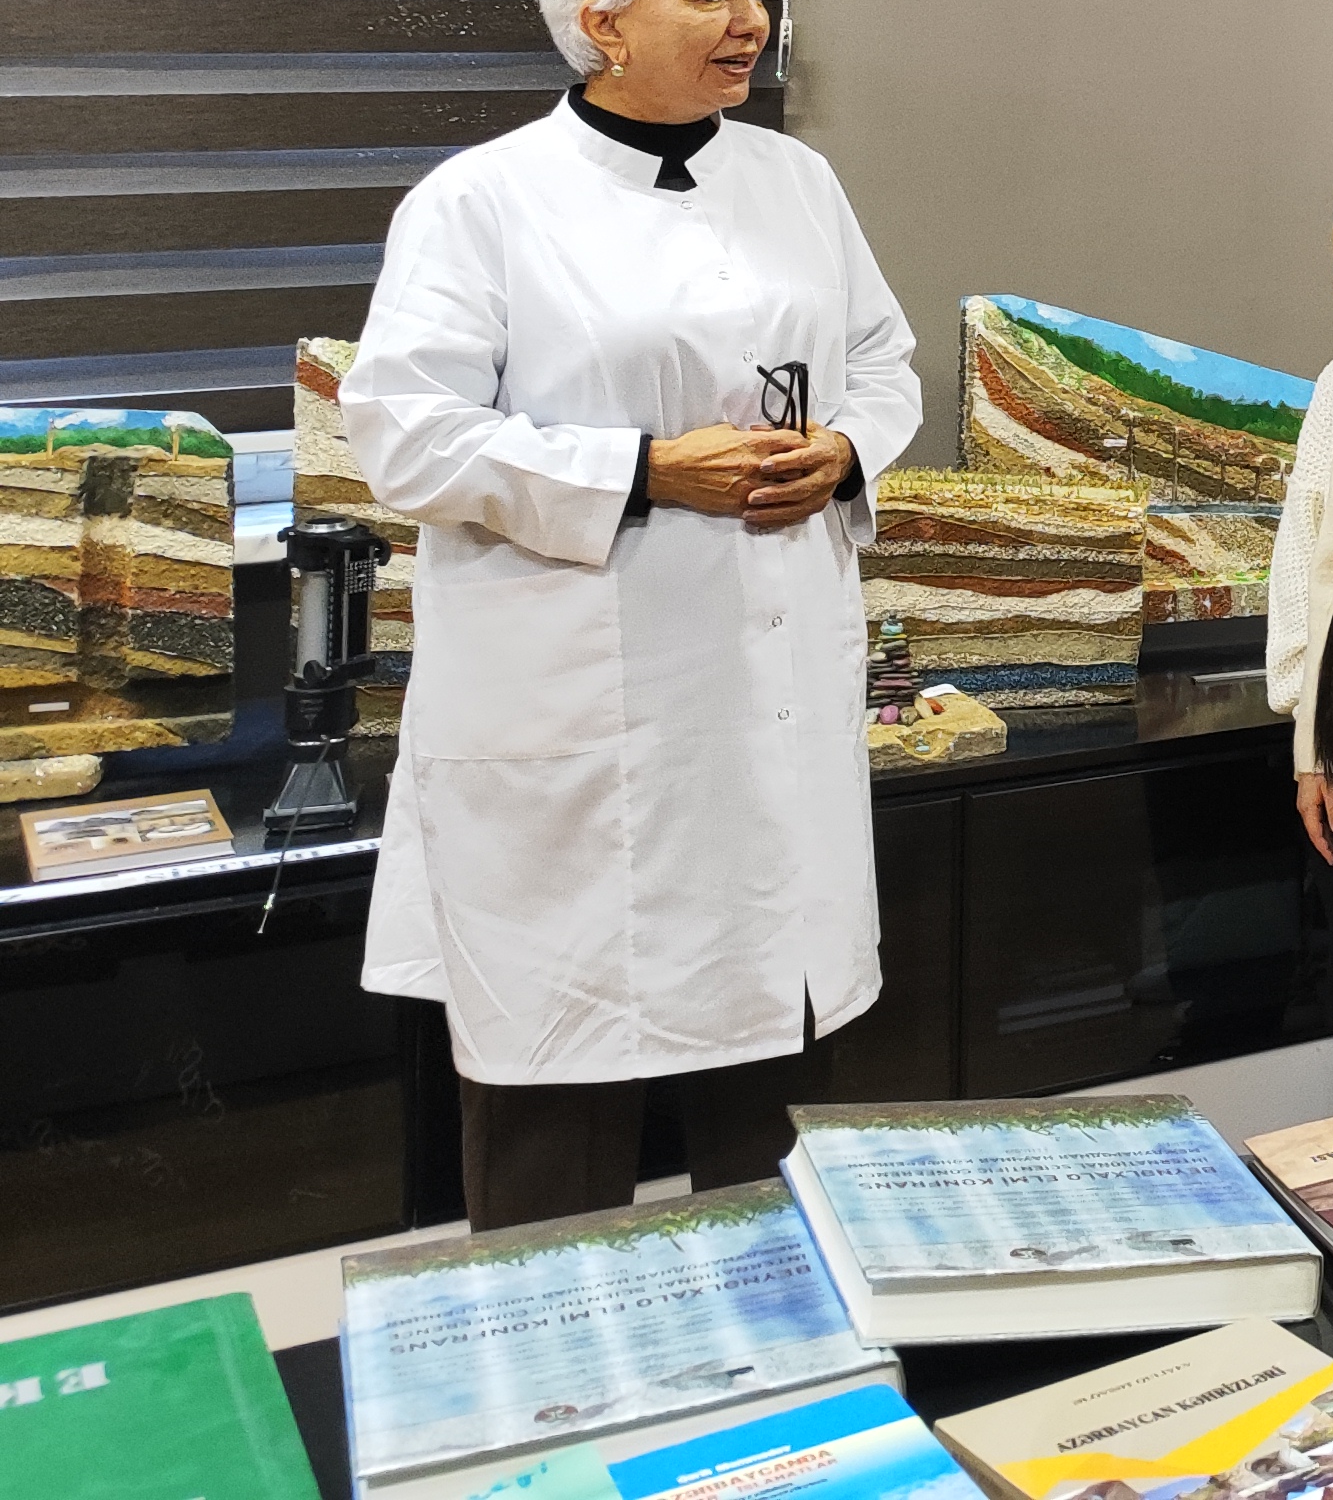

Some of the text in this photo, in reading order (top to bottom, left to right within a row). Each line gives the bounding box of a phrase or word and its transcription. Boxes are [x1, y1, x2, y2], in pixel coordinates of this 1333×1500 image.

[978, 1153, 1053, 1164] НАУЧНАЯ
[1057, 1147, 1200, 1159] МЕЖДУНАРОДНАЯ
[851, 1156, 1208, 1179] INTERNATIONAL SCIENTIFIC CONFERENCE
[999, 1172, 1057, 1186] ELMİ
[856, 1176, 992, 1190] KONFRANS
[386, 1250, 806, 1345] INTERNATIONAL SCIENTIFIC CONFERENCE
[558, 1300, 626, 1326] ELMİ
[388, 1313, 548, 1360] KONFRANS
[1057, 1404, 1178, 1453] AZƏRBAYCAN
